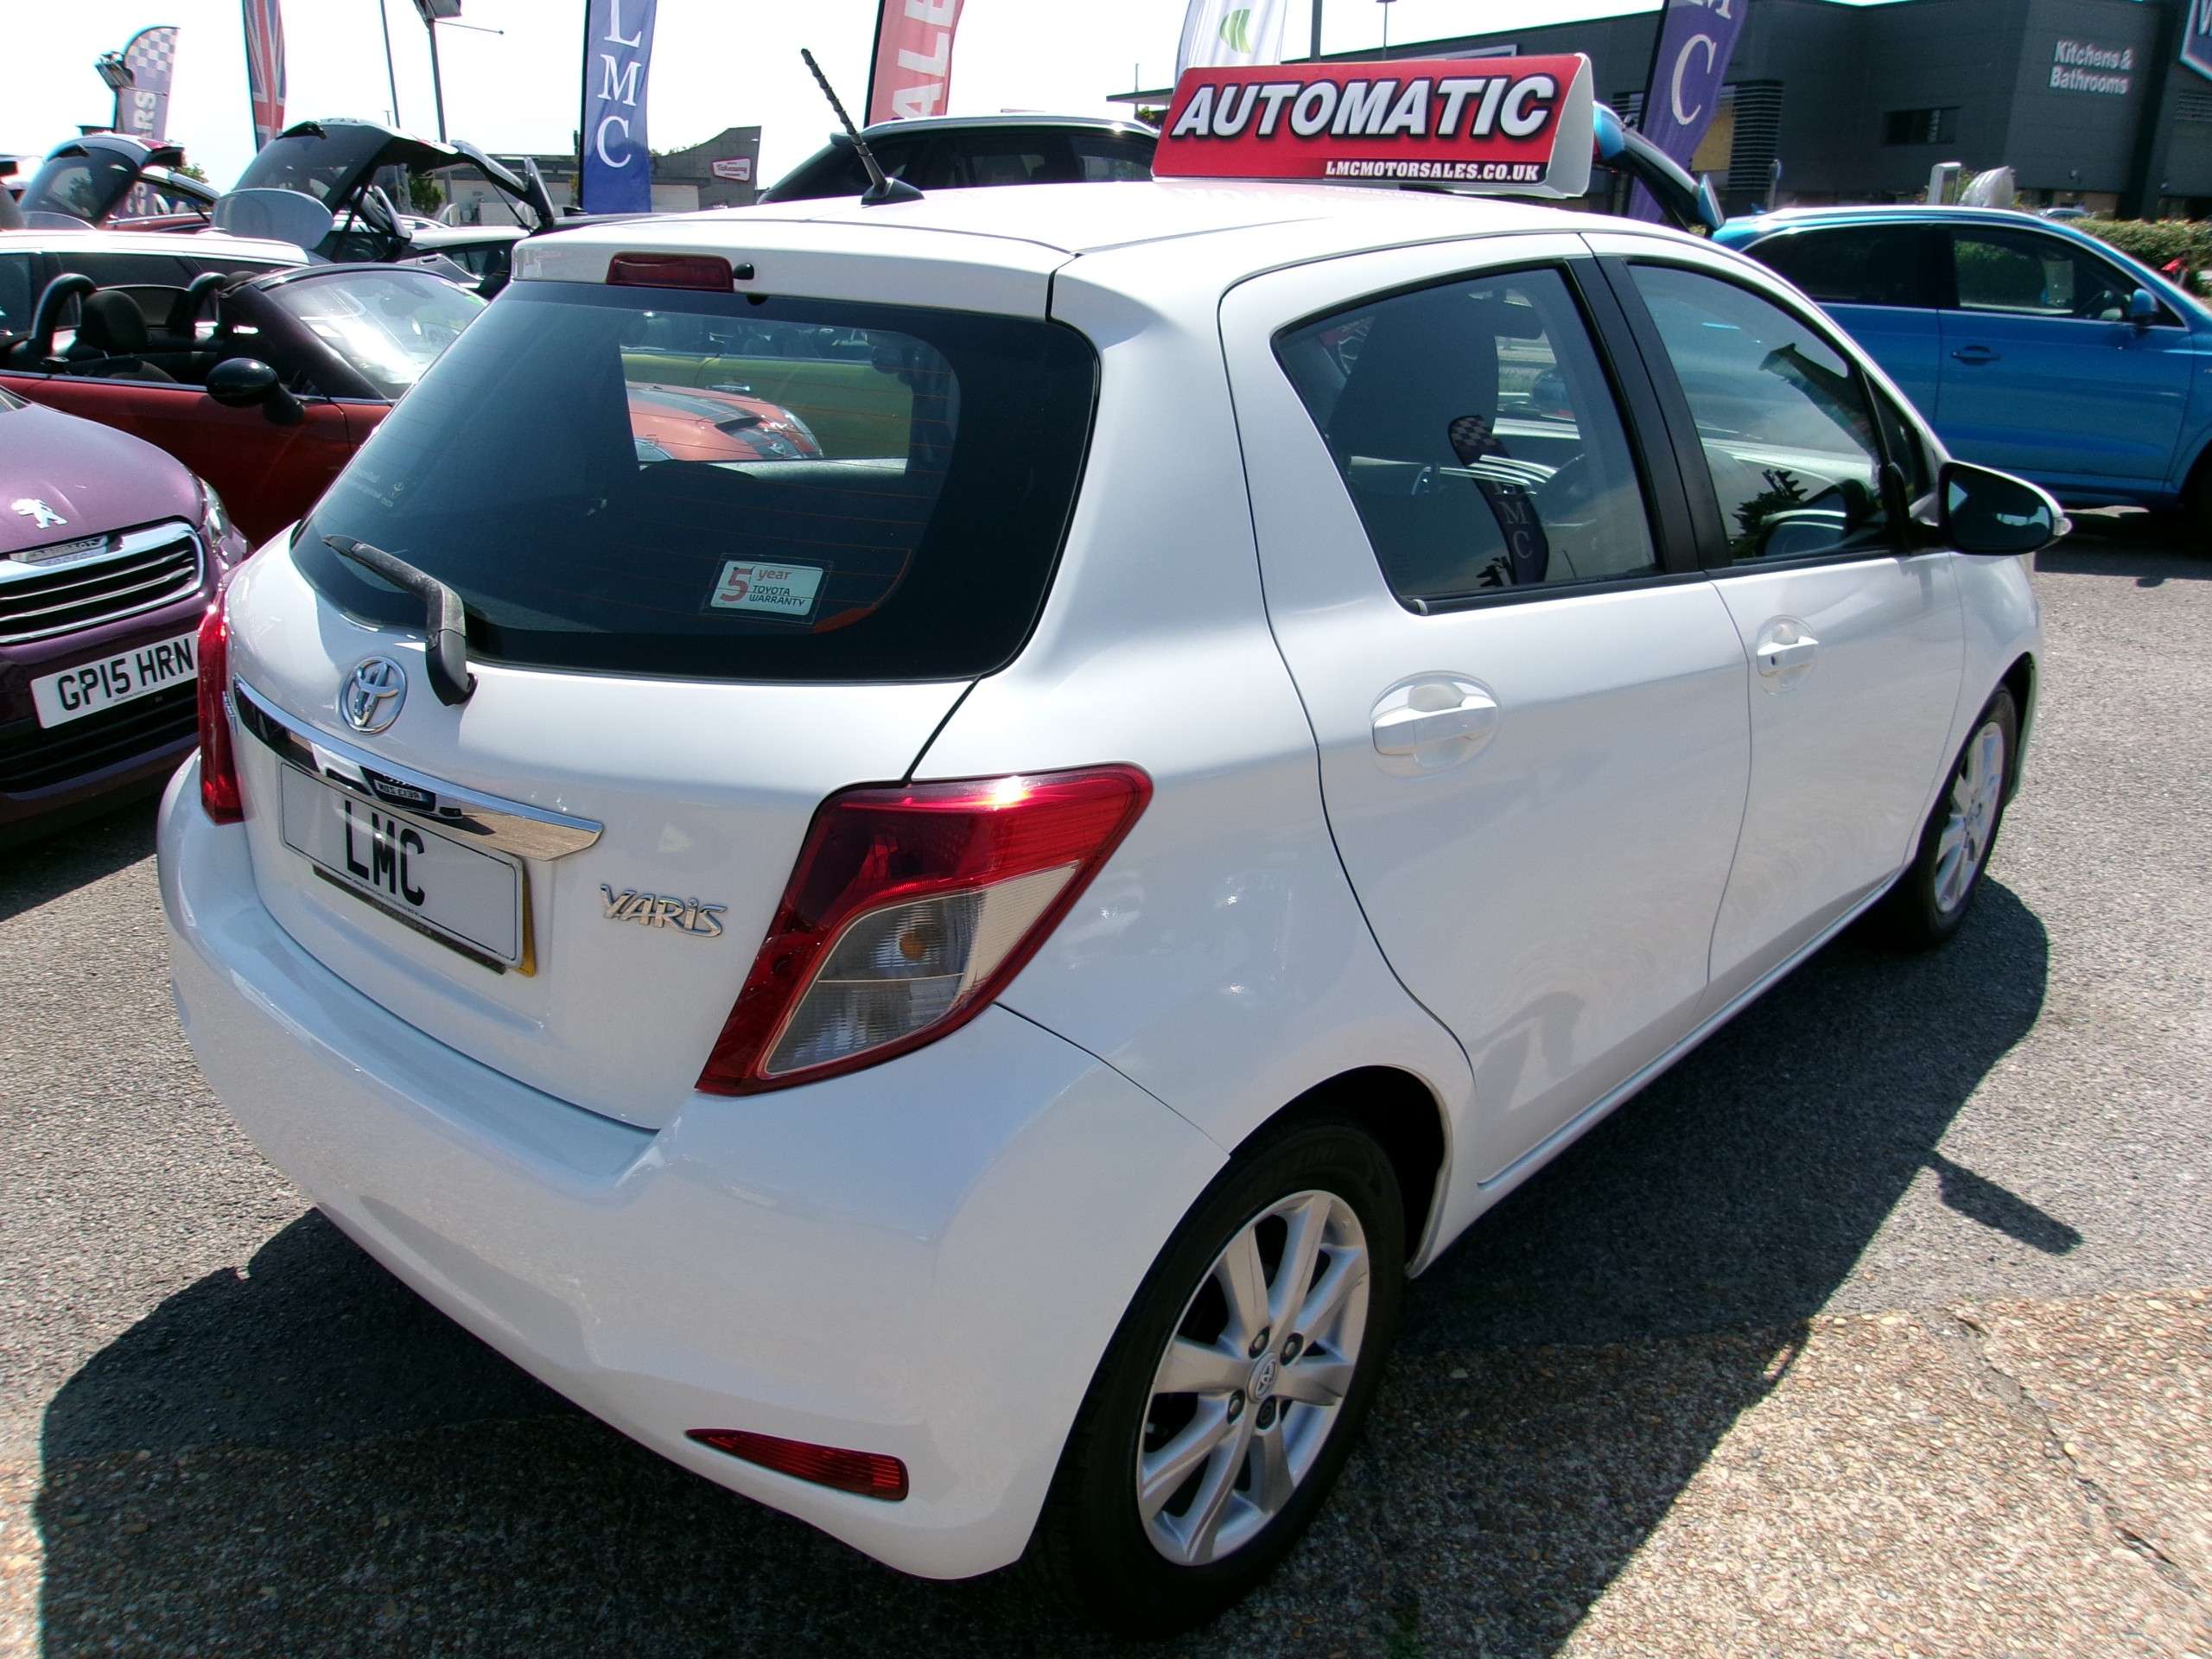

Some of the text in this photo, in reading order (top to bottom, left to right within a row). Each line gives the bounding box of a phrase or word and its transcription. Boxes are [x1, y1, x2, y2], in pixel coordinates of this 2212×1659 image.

[2054, 40, 2132, 70] Kitchens &
[2049, 66, 2128, 95] Bathrooms
[1170, 73, 1556, 138] AUTOMATIC
[1325, 159, 1540, 181] LMCMOTORSALES.CO.UK
[720, 567, 792, 602] 5 year
[752, 585, 791, 596] TOYOTA
[748, 594, 805, 607] WARRANTY
[57, 638, 194, 711] GP15 HRN
[345, 799, 426, 907] LMC
